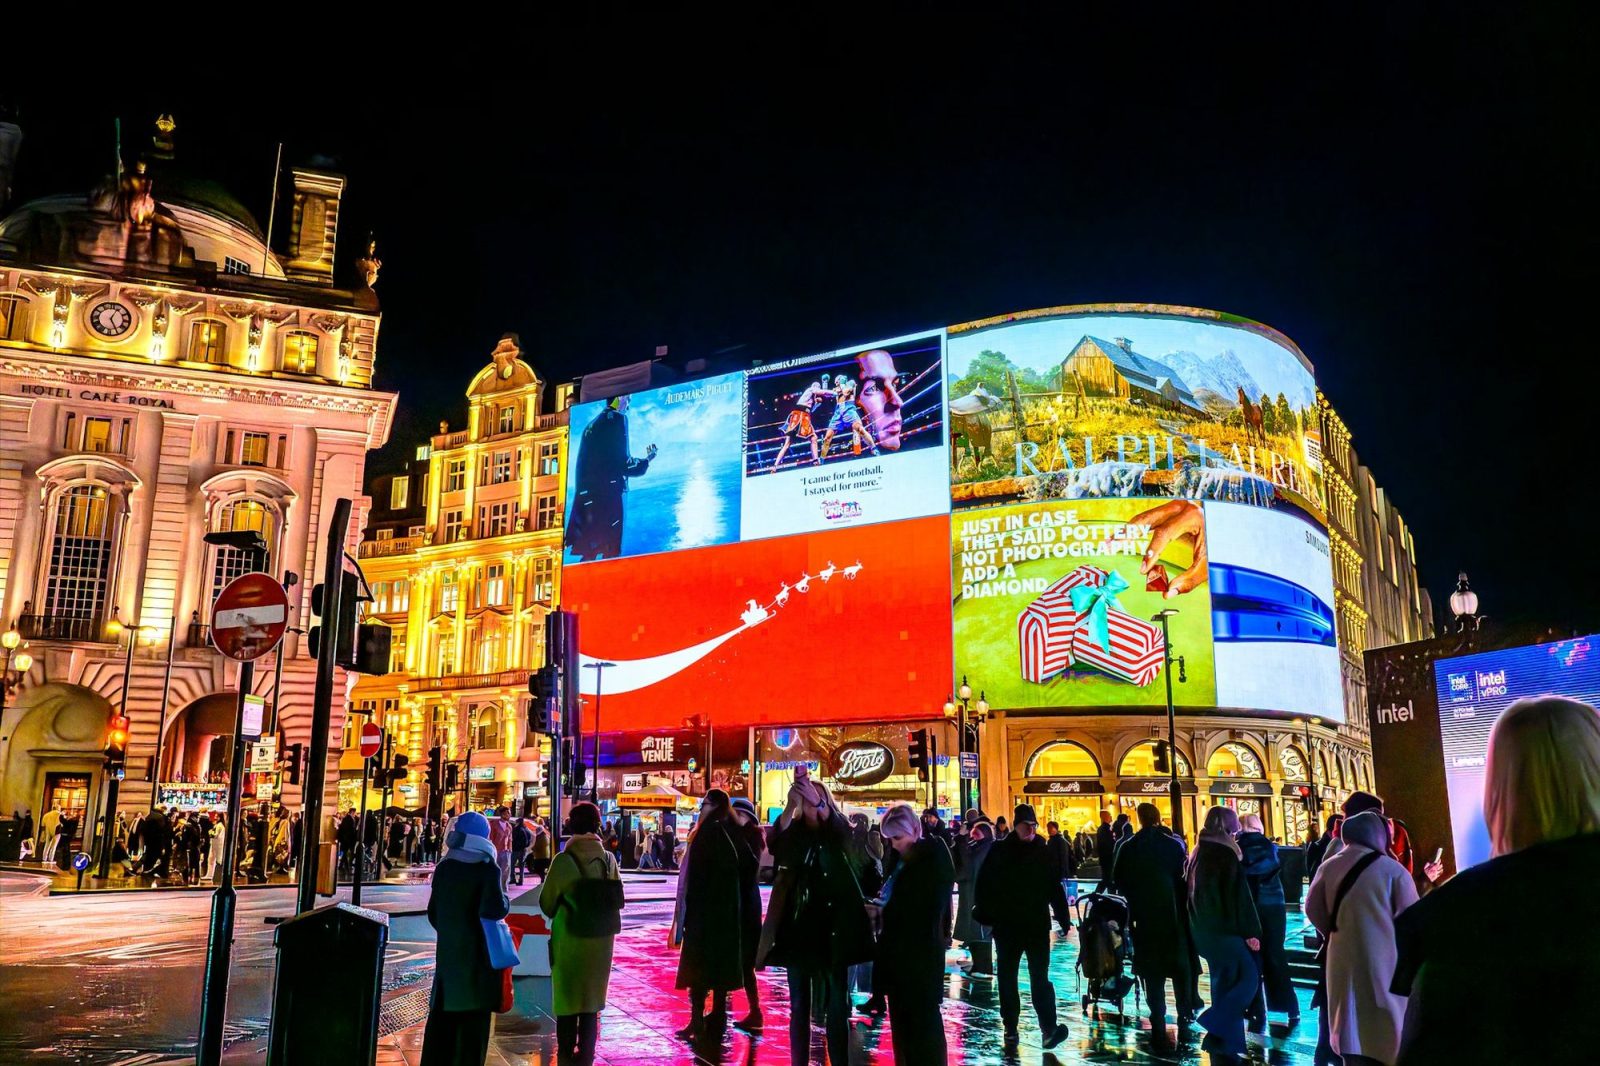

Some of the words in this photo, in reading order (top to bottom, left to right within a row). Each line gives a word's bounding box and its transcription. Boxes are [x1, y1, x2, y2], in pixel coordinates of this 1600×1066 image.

[21, 384, 72, 399] HOTEL
[128, 395, 176, 410] ROYAL
[1013, 435, 1175, 476] RALPH
[808, 475, 831, 484] came
[833, 472, 845, 481] for
[847, 465, 883, 478] football.
[809, 483, 837, 496] stayed
[839, 482, 851, 491] for
[960, 516, 1002, 536] JUST
[1005, 513, 1024, 531] IN
[1028, 510, 1079, 528] CASE
[961, 532, 1010, 551] THEY
[1011, 527, 1056, 546] SAID
[1061, 524, 1151, 541] POTTERY
[961, 549, 1000, 567] NOT
[1002, 541, 1154, 563] PHOTOGRAPHY,
[961, 566, 999, 583] ADD
[1003, 563, 1016, 578] A
[962, 577, 1049, 600] DIAMOND
[1479, 670, 1505, 687] intel
[1481, 685, 1507, 697] vPRO
[1377, 699, 1413, 724] intel
[655, 737, 675, 750] THE
[641, 749, 674, 763] VENUE
[835, 749, 885, 779] Boots
[626, 779, 650, 787] oass
[1047, 782, 1072, 792] Lindt
[1141, 782, 1167, 792] Lindt
[1228, 783, 1249, 793] Lindt
